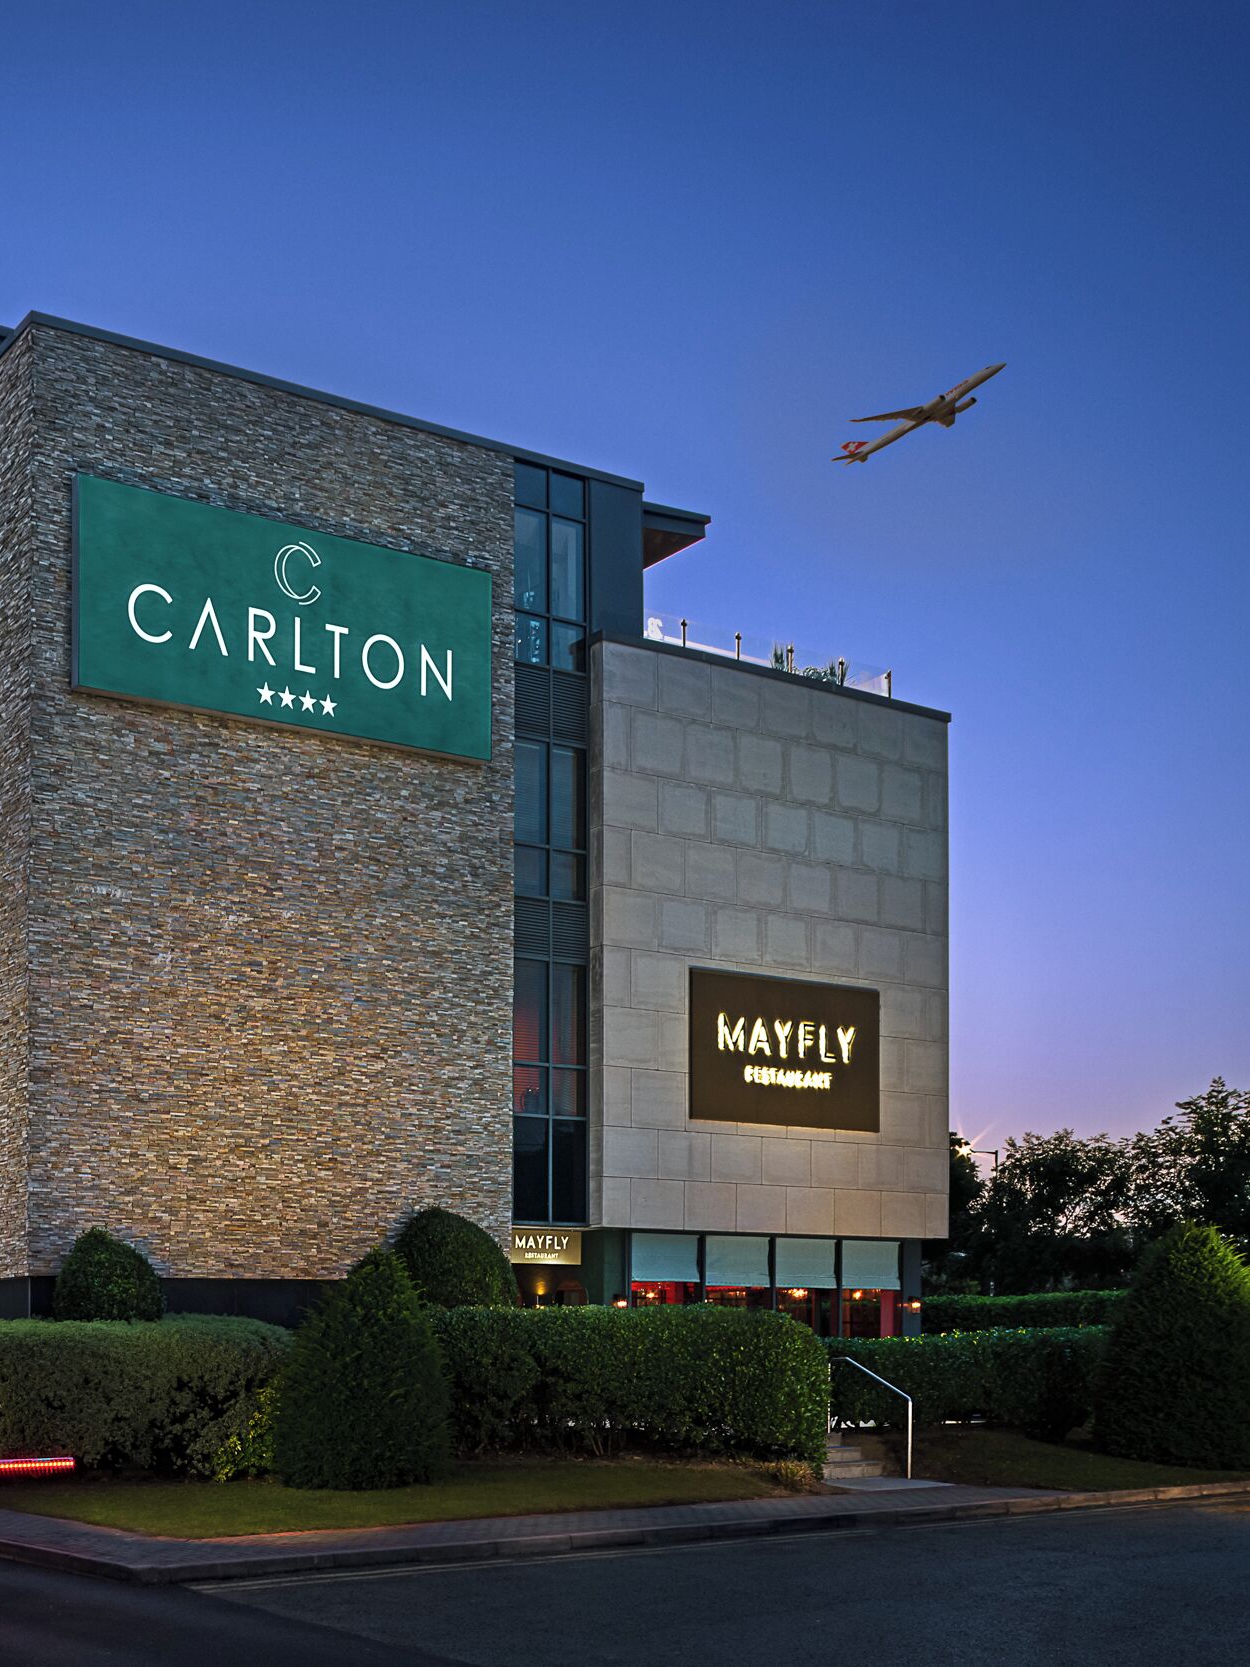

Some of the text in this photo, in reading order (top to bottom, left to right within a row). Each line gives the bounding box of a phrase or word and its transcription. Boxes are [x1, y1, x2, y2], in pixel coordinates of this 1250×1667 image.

[127, 583, 453, 702] CARLTON
[717, 1012, 857, 1064] MAYFLY
[743, 1065, 833, 1090] RESTAURANT
[515, 1234, 569, 1250] MAYFLY
